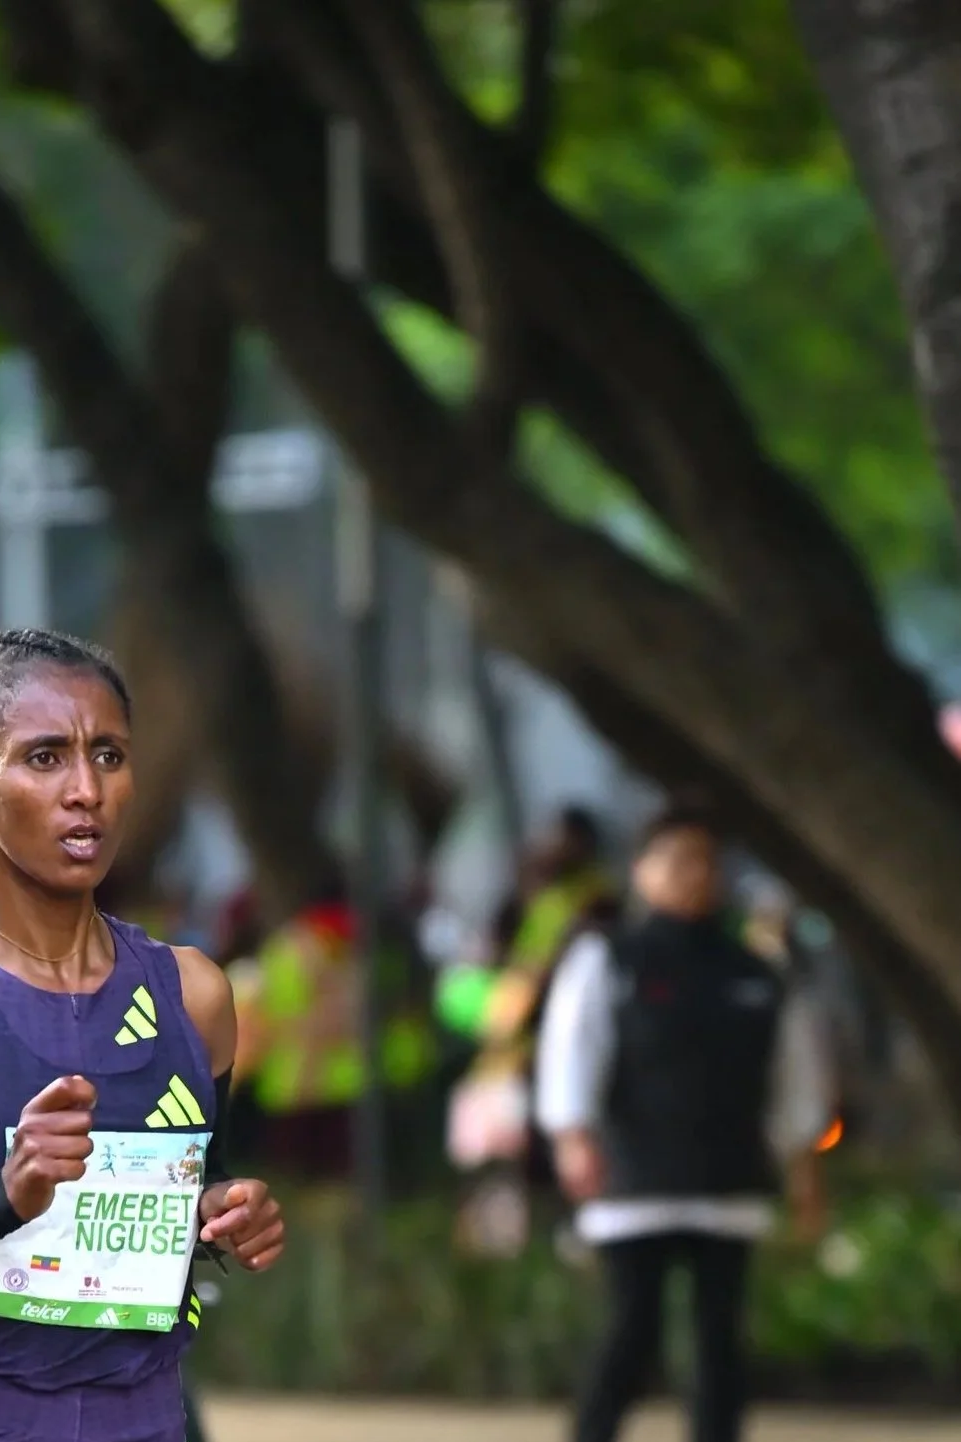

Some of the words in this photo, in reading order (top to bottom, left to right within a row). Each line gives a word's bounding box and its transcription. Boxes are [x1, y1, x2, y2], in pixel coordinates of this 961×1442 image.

[75, 1192, 193, 1224] EMEBET
[75, 1221, 188, 1255] NIGUSE
[20, 1301, 71, 1321] telcel
[146, 1311, 176, 1327] BBV
